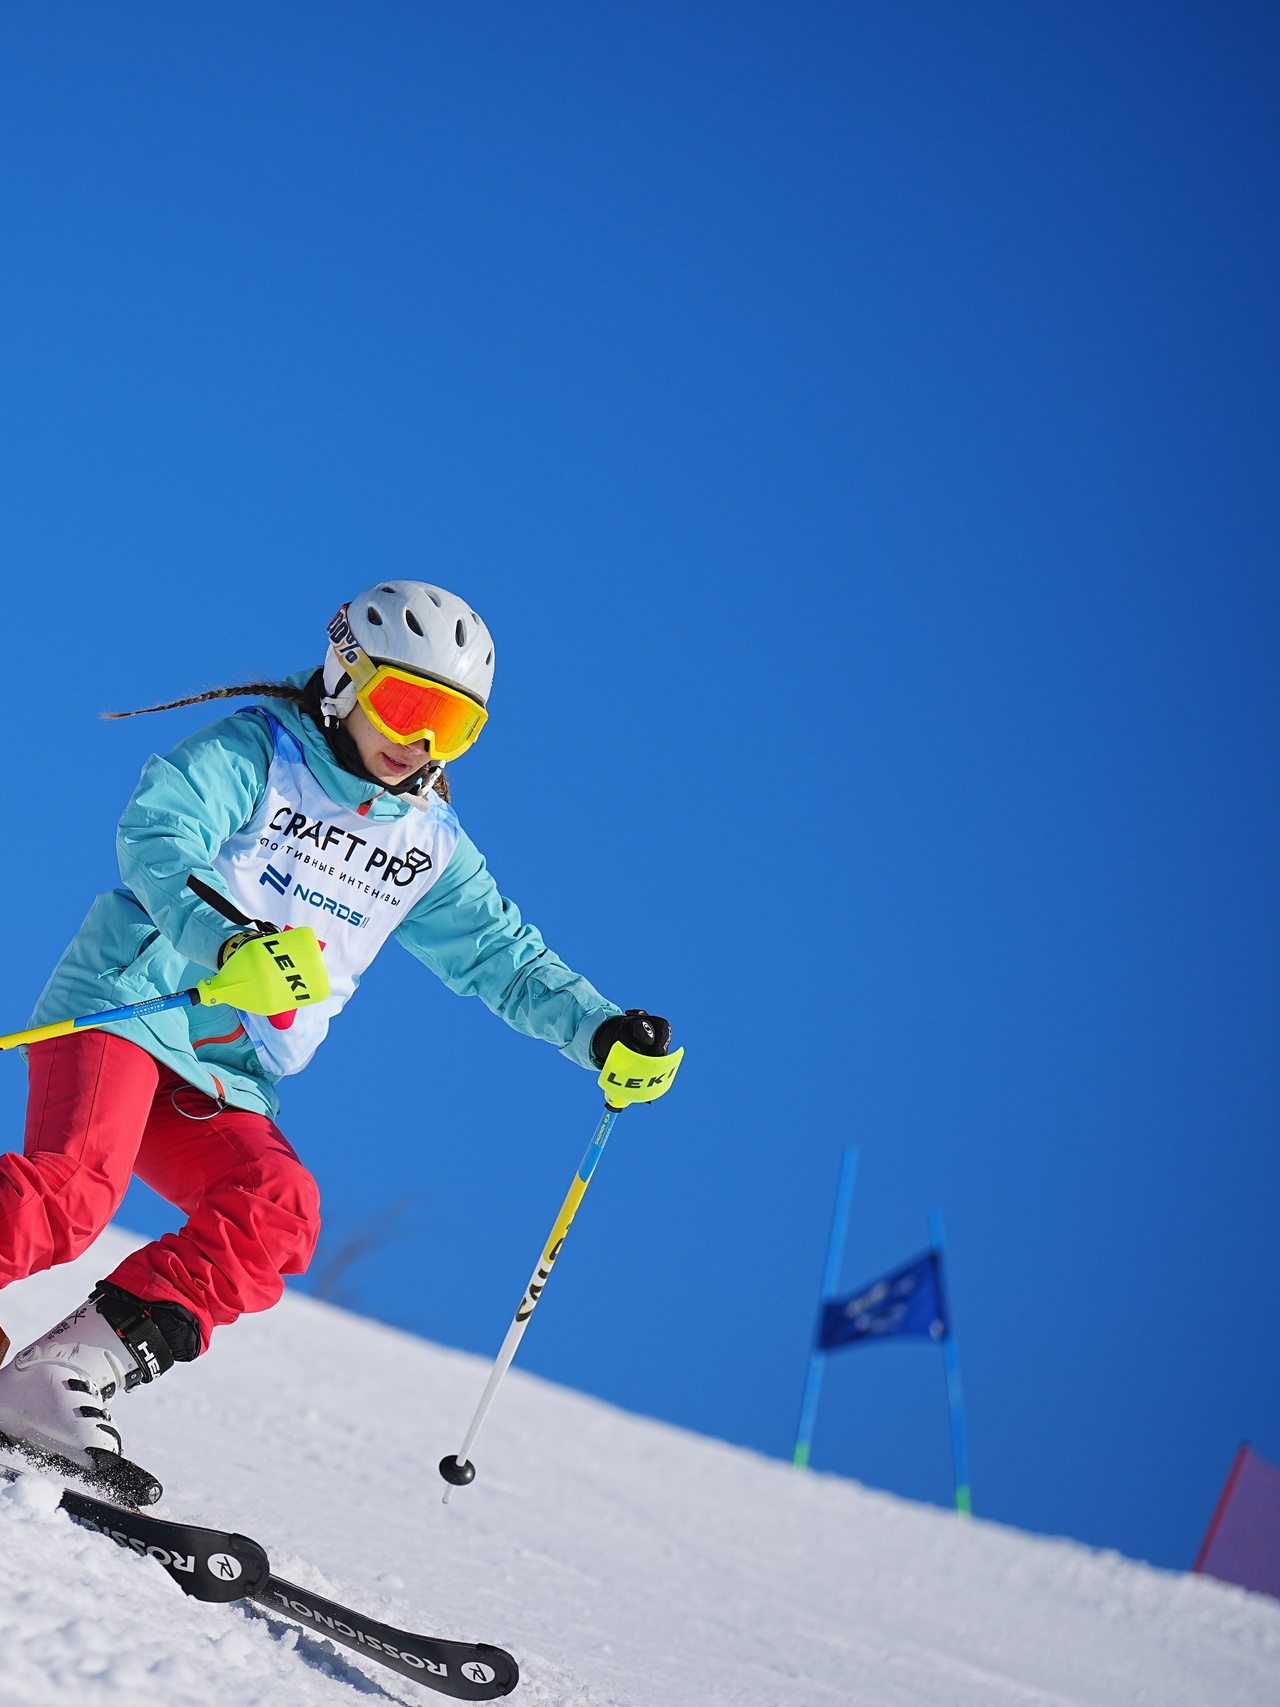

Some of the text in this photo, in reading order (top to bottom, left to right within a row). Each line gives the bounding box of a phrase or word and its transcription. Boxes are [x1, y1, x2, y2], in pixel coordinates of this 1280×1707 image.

[260, 837, 401, 907] СПОТИВНЫЕ ИНТЕНВЫ
[268, 807, 432, 887] CRAFT PRO
[293, 884, 370, 928] NORDS
[262, 940, 311, 1001] LEKI
[606, 1066, 677, 1089] LEKI
[273, 1591, 448, 1678] ROSSIGNOL
